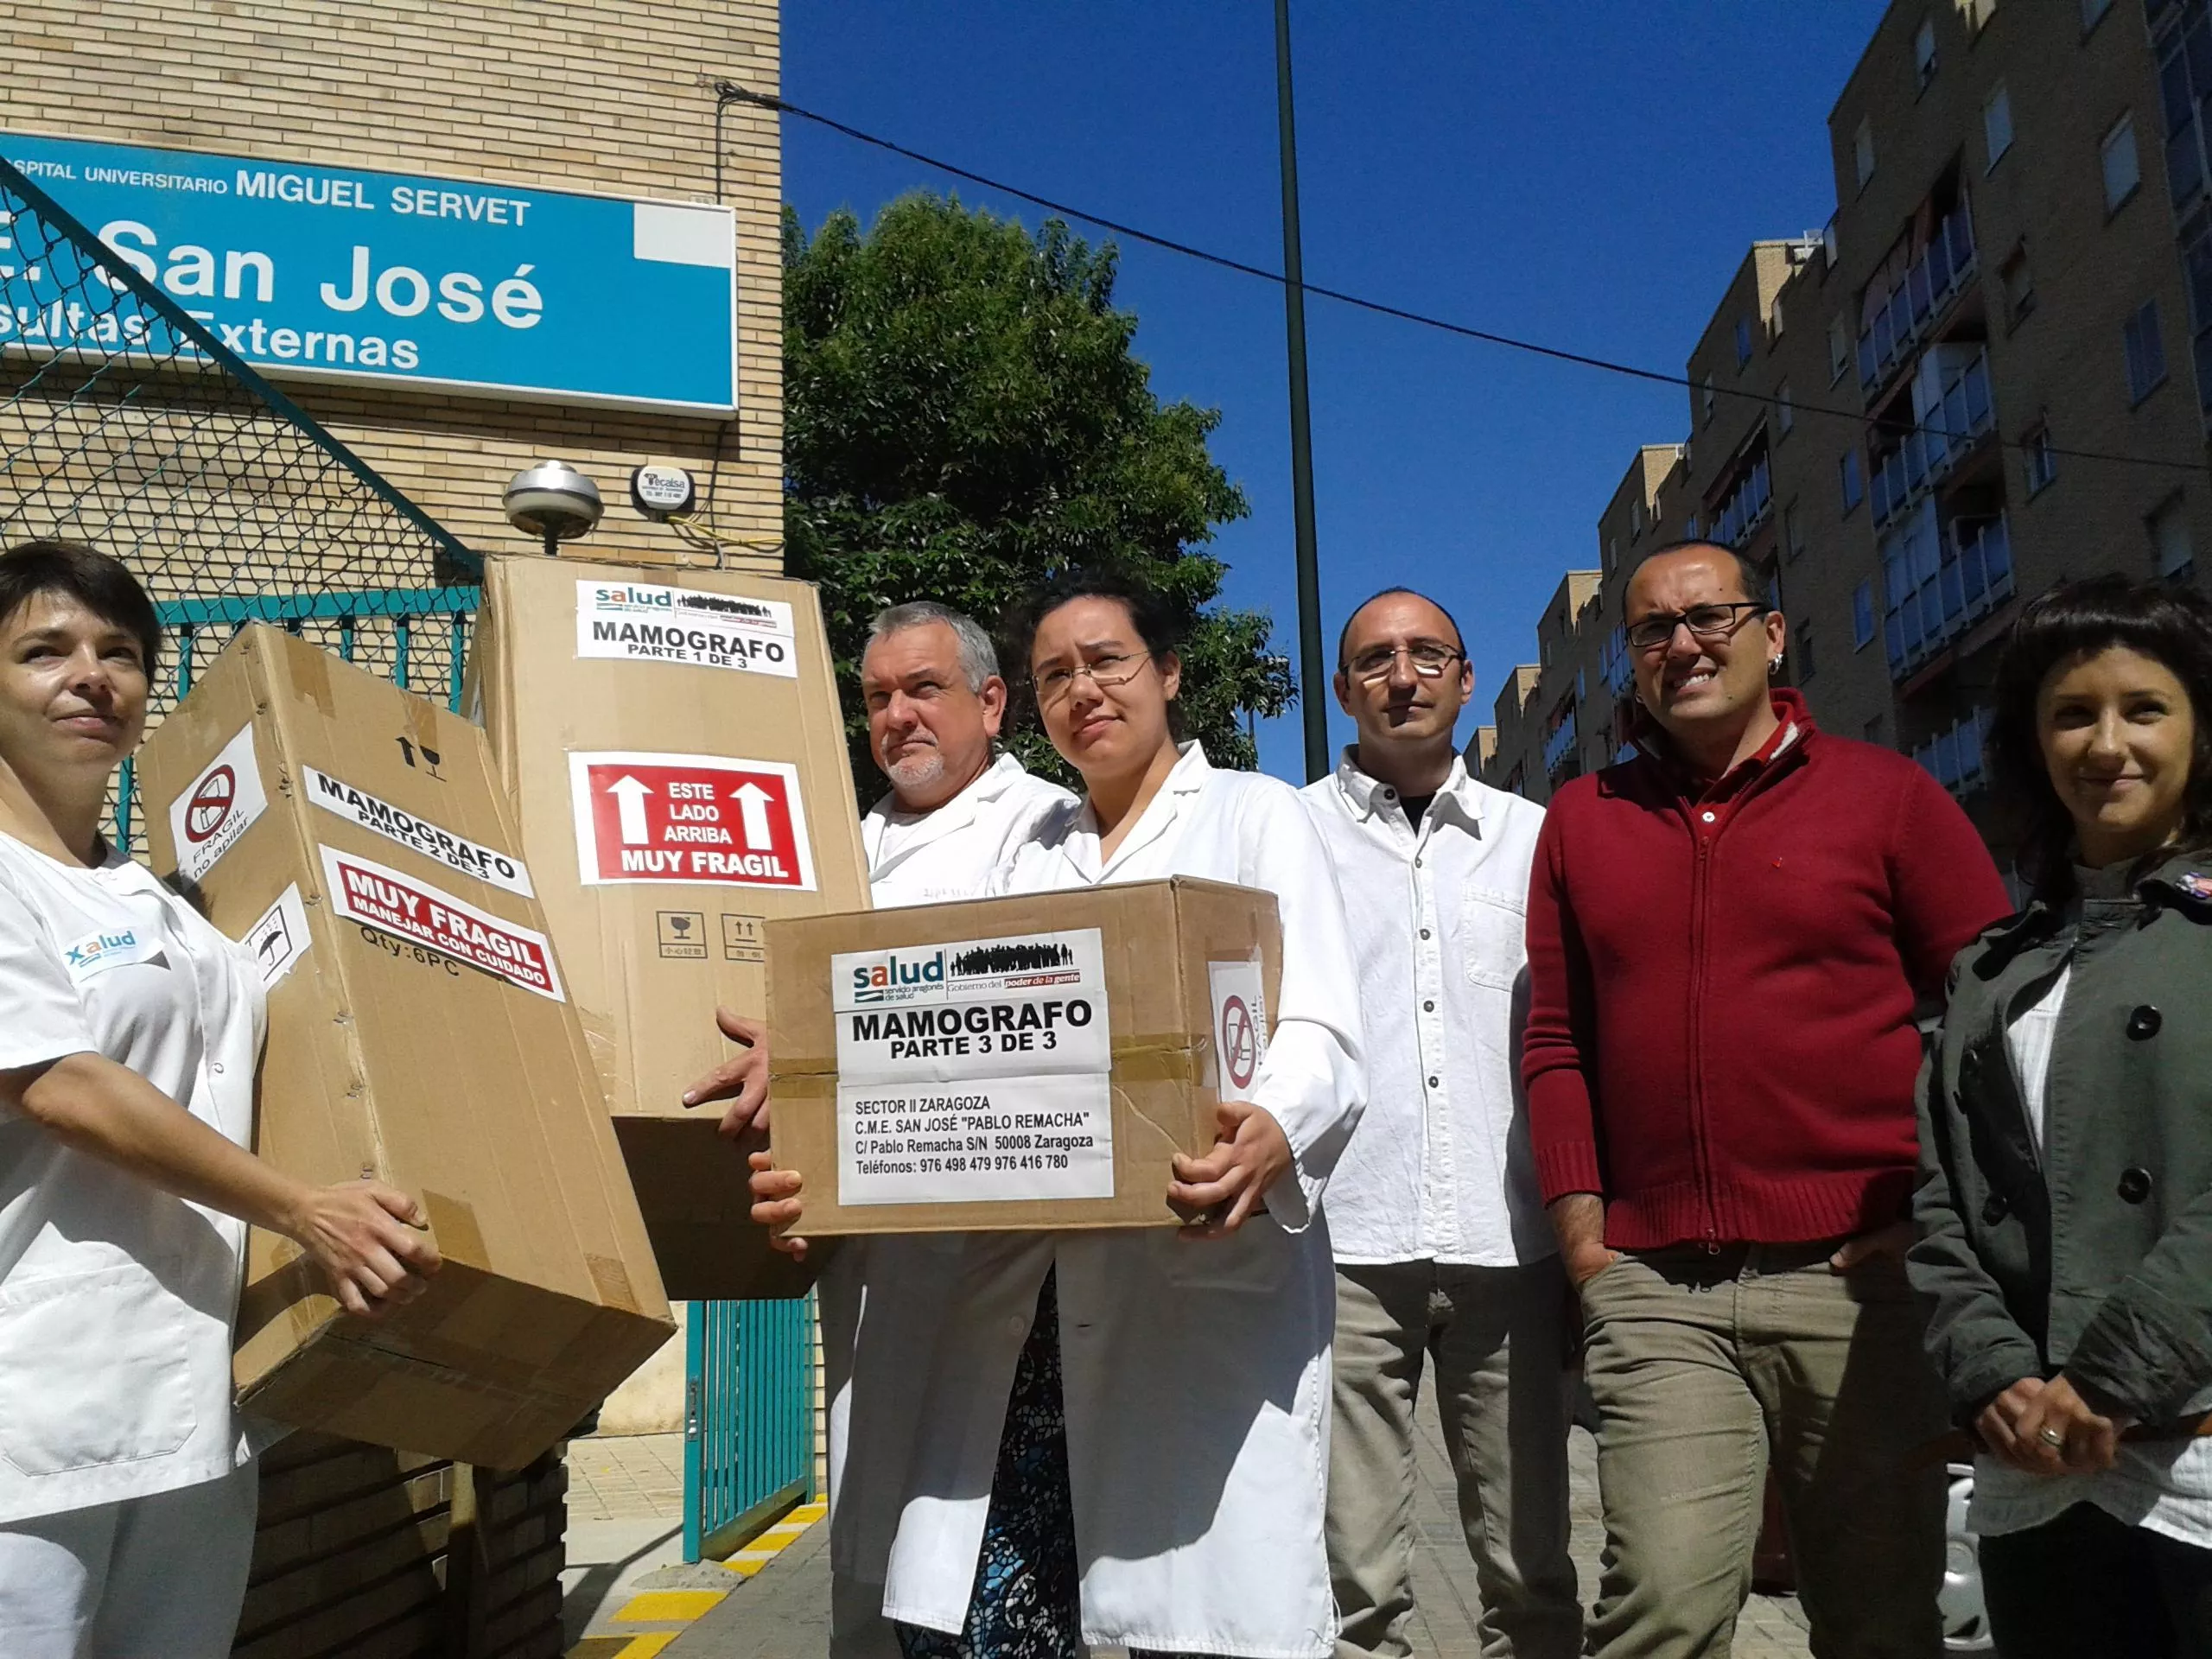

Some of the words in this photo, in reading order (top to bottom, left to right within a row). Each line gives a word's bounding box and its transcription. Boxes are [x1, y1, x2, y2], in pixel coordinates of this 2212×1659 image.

[5, 159, 77, 180] SPITAL
[85, 167, 228, 194] UNIVERSITARIO
[236, 170, 374, 210] MIGUEL
[391, 187, 531, 226] SERVET
[94, 219, 274, 303] San
[320, 245, 543, 328] José
[595, 588, 672, 607] salud
[592, 621, 785, 663] MAMOGRAFO
[627, 644, 688, 660] PARTE
[693, 652, 702, 662] 1
[709, 653, 733, 666] DE
[737, 658, 747, 669] 3
[668, 782, 715, 800] ESTE
[317, 772, 516, 879] MAMOGRAFO
[669, 804, 720, 822] LADO
[193, 809, 245, 864] FRAGIL
[193, 858, 211, 878] no
[213, 817, 250, 859] apilar
[359, 810, 423, 849] PARTE
[429, 844, 441, 858] 2
[447, 853, 473, 872] DE
[477, 868, 490, 879] 3
[664, 826, 733, 844] ARRIBA
[621, 849, 683, 872] MUY
[690, 851, 789, 878] FRAGIL
[346, 869, 420, 918] MUY
[429, 903, 542, 969] FRAGIL
[353, 895, 435, 940] MANEJAR
[437, 933, 473, 957] CON
[475, 949, 546, 985] CUIDADO
[853, 951, 944, 988] salud
[947, 982, 987, 993] Gobierno
[1005, 977, 1032, 988] poder
[1033, 976, 1045, 985] de
[1045, 976, 1053, 984] la
[1054, 973, 1080, 986] gente
[852, 1000, 1092, 1042] MAMOGRAFO
[890, 1037, 970, 1059] PARTE
[978, 1035, 992, 1054] 3
[1001, 1033, 1034, 1052] DE
[1042, 1031, 1057, 1050] 3
[855, 1100, 906, 1116] SECTOR
[909, 1098, 917, 1112] II
[918, 1096, 990, 1112] ZARAGOZA
[855, 1120, 892, 1135] C.M.E.
[895, 1118, 921, 1133] SAN
[925, 1113, 957, 1132] JOSÉ
[961, 1115, 1011, 1131] "PABLO
[1015, 1111, 1090, 1129] REMACHA"
[855, 1139, 868, 1154] C/
[870, 1138, 904, 1154] Pablo
[906, 1137, 963, 1153] Remacha
[966, 1135, 988, 1152] S/N
[995, 1135, 1032, 1150] 50008
[1034, 1134, 1094, 1152] Zaragoza
[855, 1158, 917, 1175] Teléfonos:
[920, 1158, 942, 1173] 976
[944, 1157, 966, 1172] 498
[969, 1156, 991, 1171] 479
[995, 1155, 1016, 1170] 976
[1020, 1154, 1042, 1169] 416
[1045, 1154, 1069, 1169] 780
